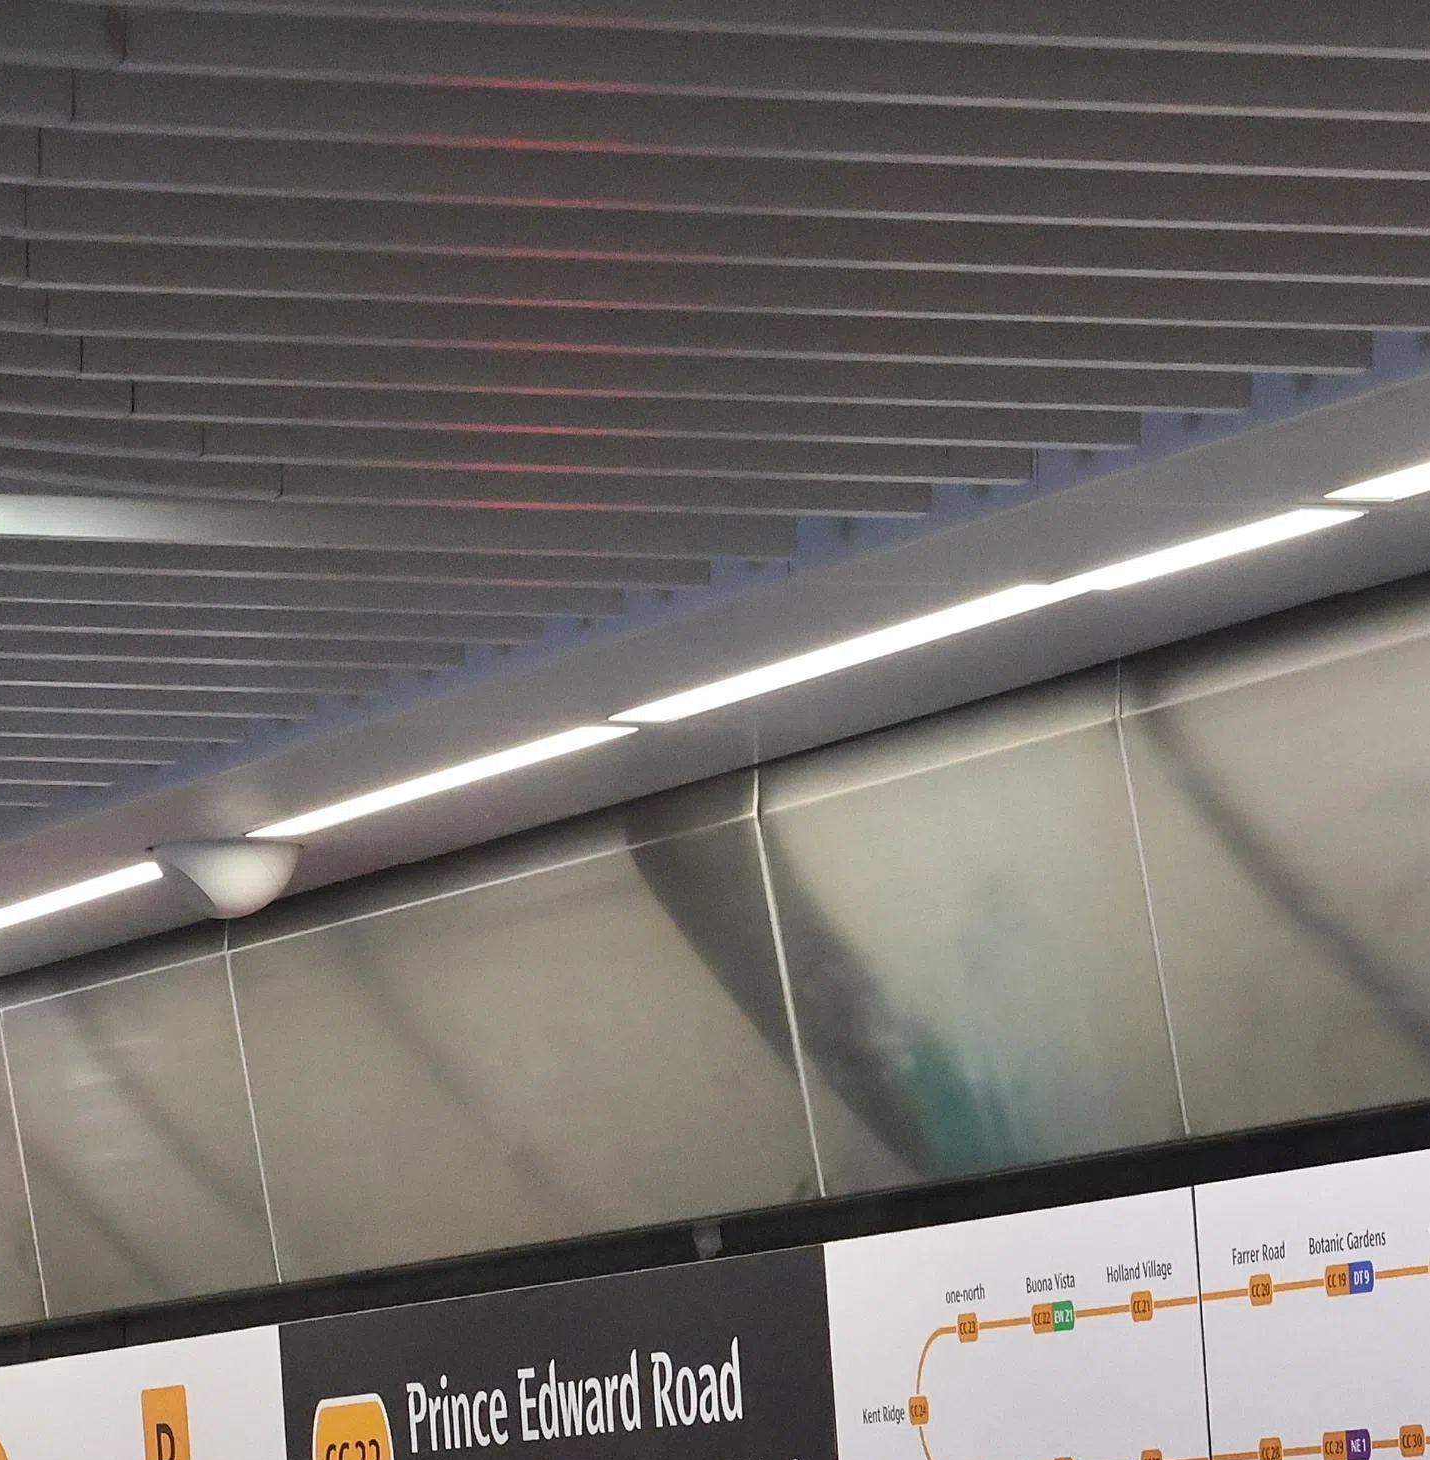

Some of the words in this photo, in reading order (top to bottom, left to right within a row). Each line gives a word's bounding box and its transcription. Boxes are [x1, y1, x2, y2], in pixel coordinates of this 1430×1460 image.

[1232, 1248, 1259, 1265] Farrer
[1262, 1240, 1285, 1261] Road
[1309, 1233, 1344, 1254] Botanic
[1347, 1229, 1386, 1250] Gardens
[1026, 1277, 1053, 1293] Buona
[1054, 1272, 1075, 1290] Vista
[1106, 1262, 1140, 1283] Holland
[1142, 1260, 1172, 1280] Village
[945, 1282, 985, 1304] one-north
[405, 1374, 509, 1454] Prince
[517, 1348, 642, 1441] Edward
[650, 1335, 743, 1428] Road
[862, 1408, 881, 1424] Kent
[883, 1405, 905, 1424] Ridge
